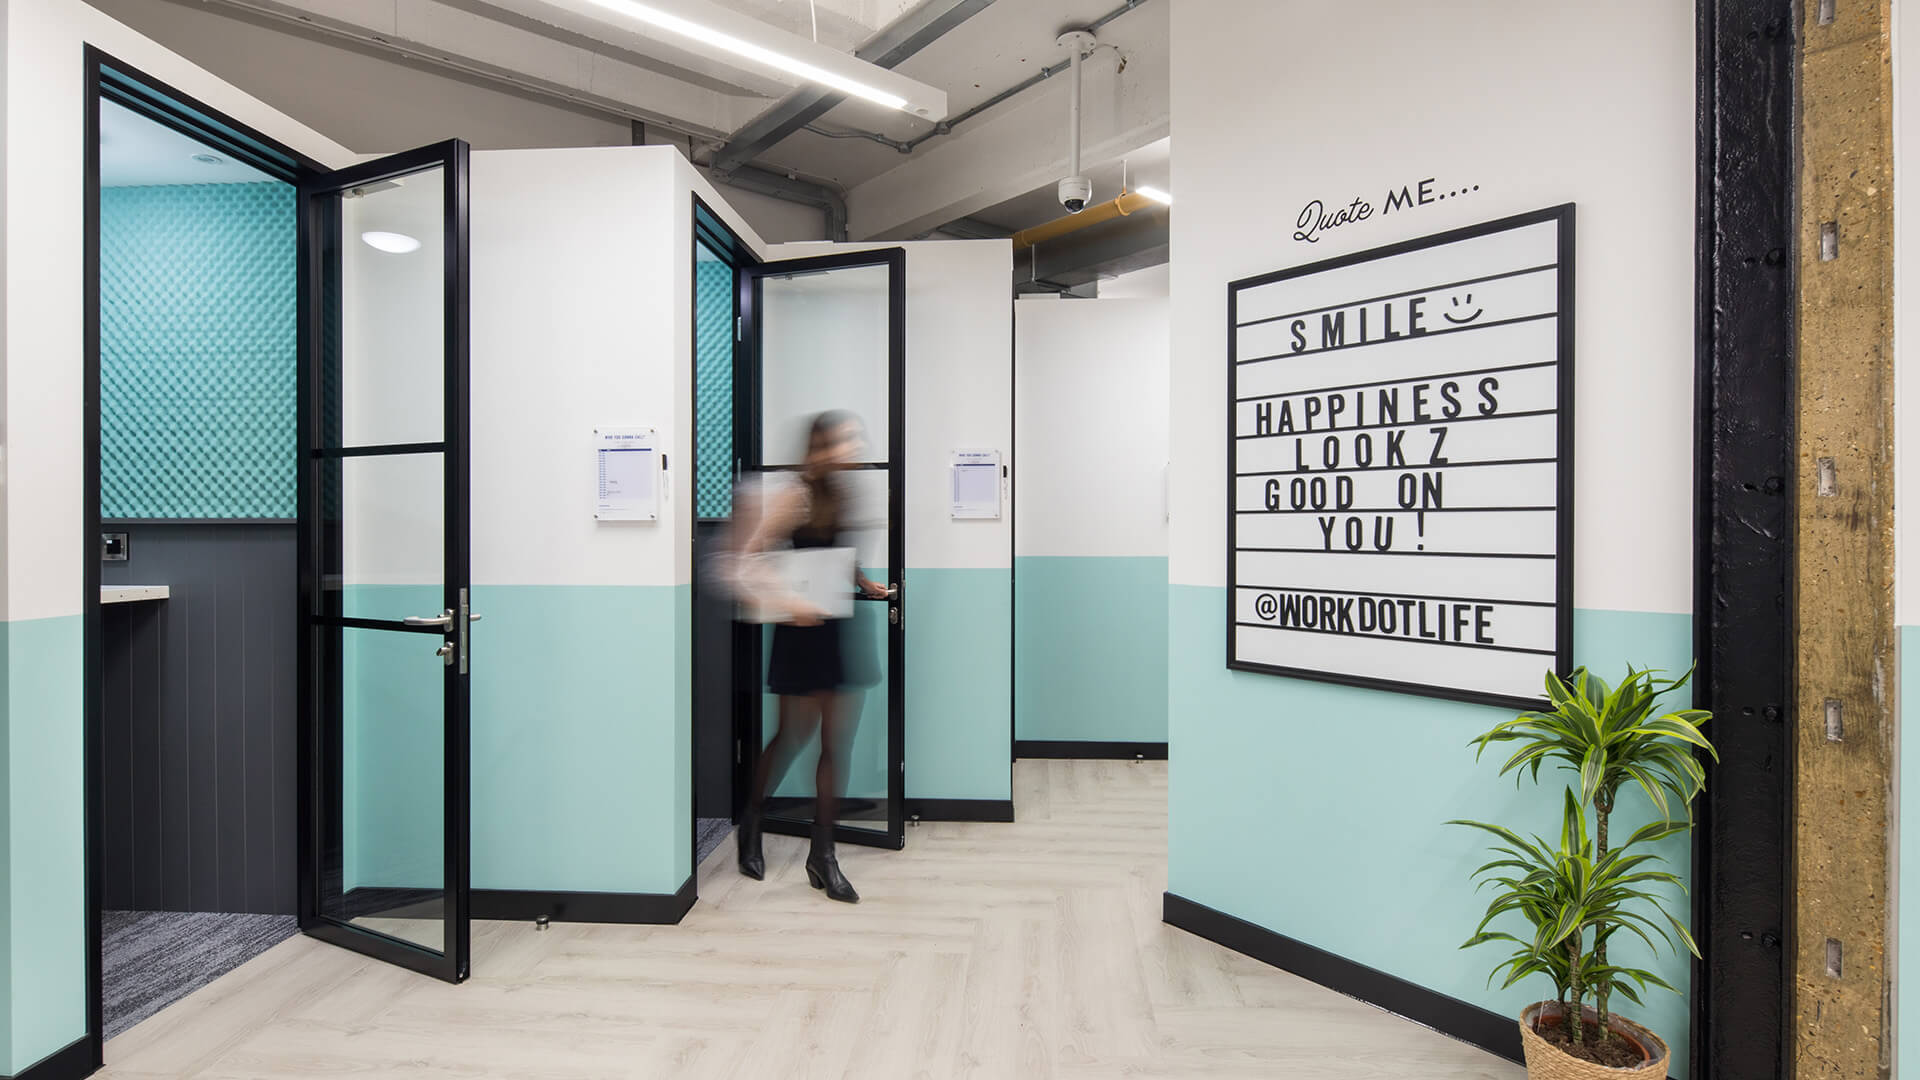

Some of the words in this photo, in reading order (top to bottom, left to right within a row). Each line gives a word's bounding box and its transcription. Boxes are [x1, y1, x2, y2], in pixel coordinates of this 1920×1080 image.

[1293, 197, 1374, 243] Quote
[1290, 297, 1427, 354] SMILE
[1255, 377, 1500, 437] HAPPINESS
[1295, 427, 1449, 472] LOOKZ
[1264, 475, 1354, 511] GOOD
[1397, 472, 1443, 511] ON
[1254, 593, 1495, 645] @WORKDOTLIFE
